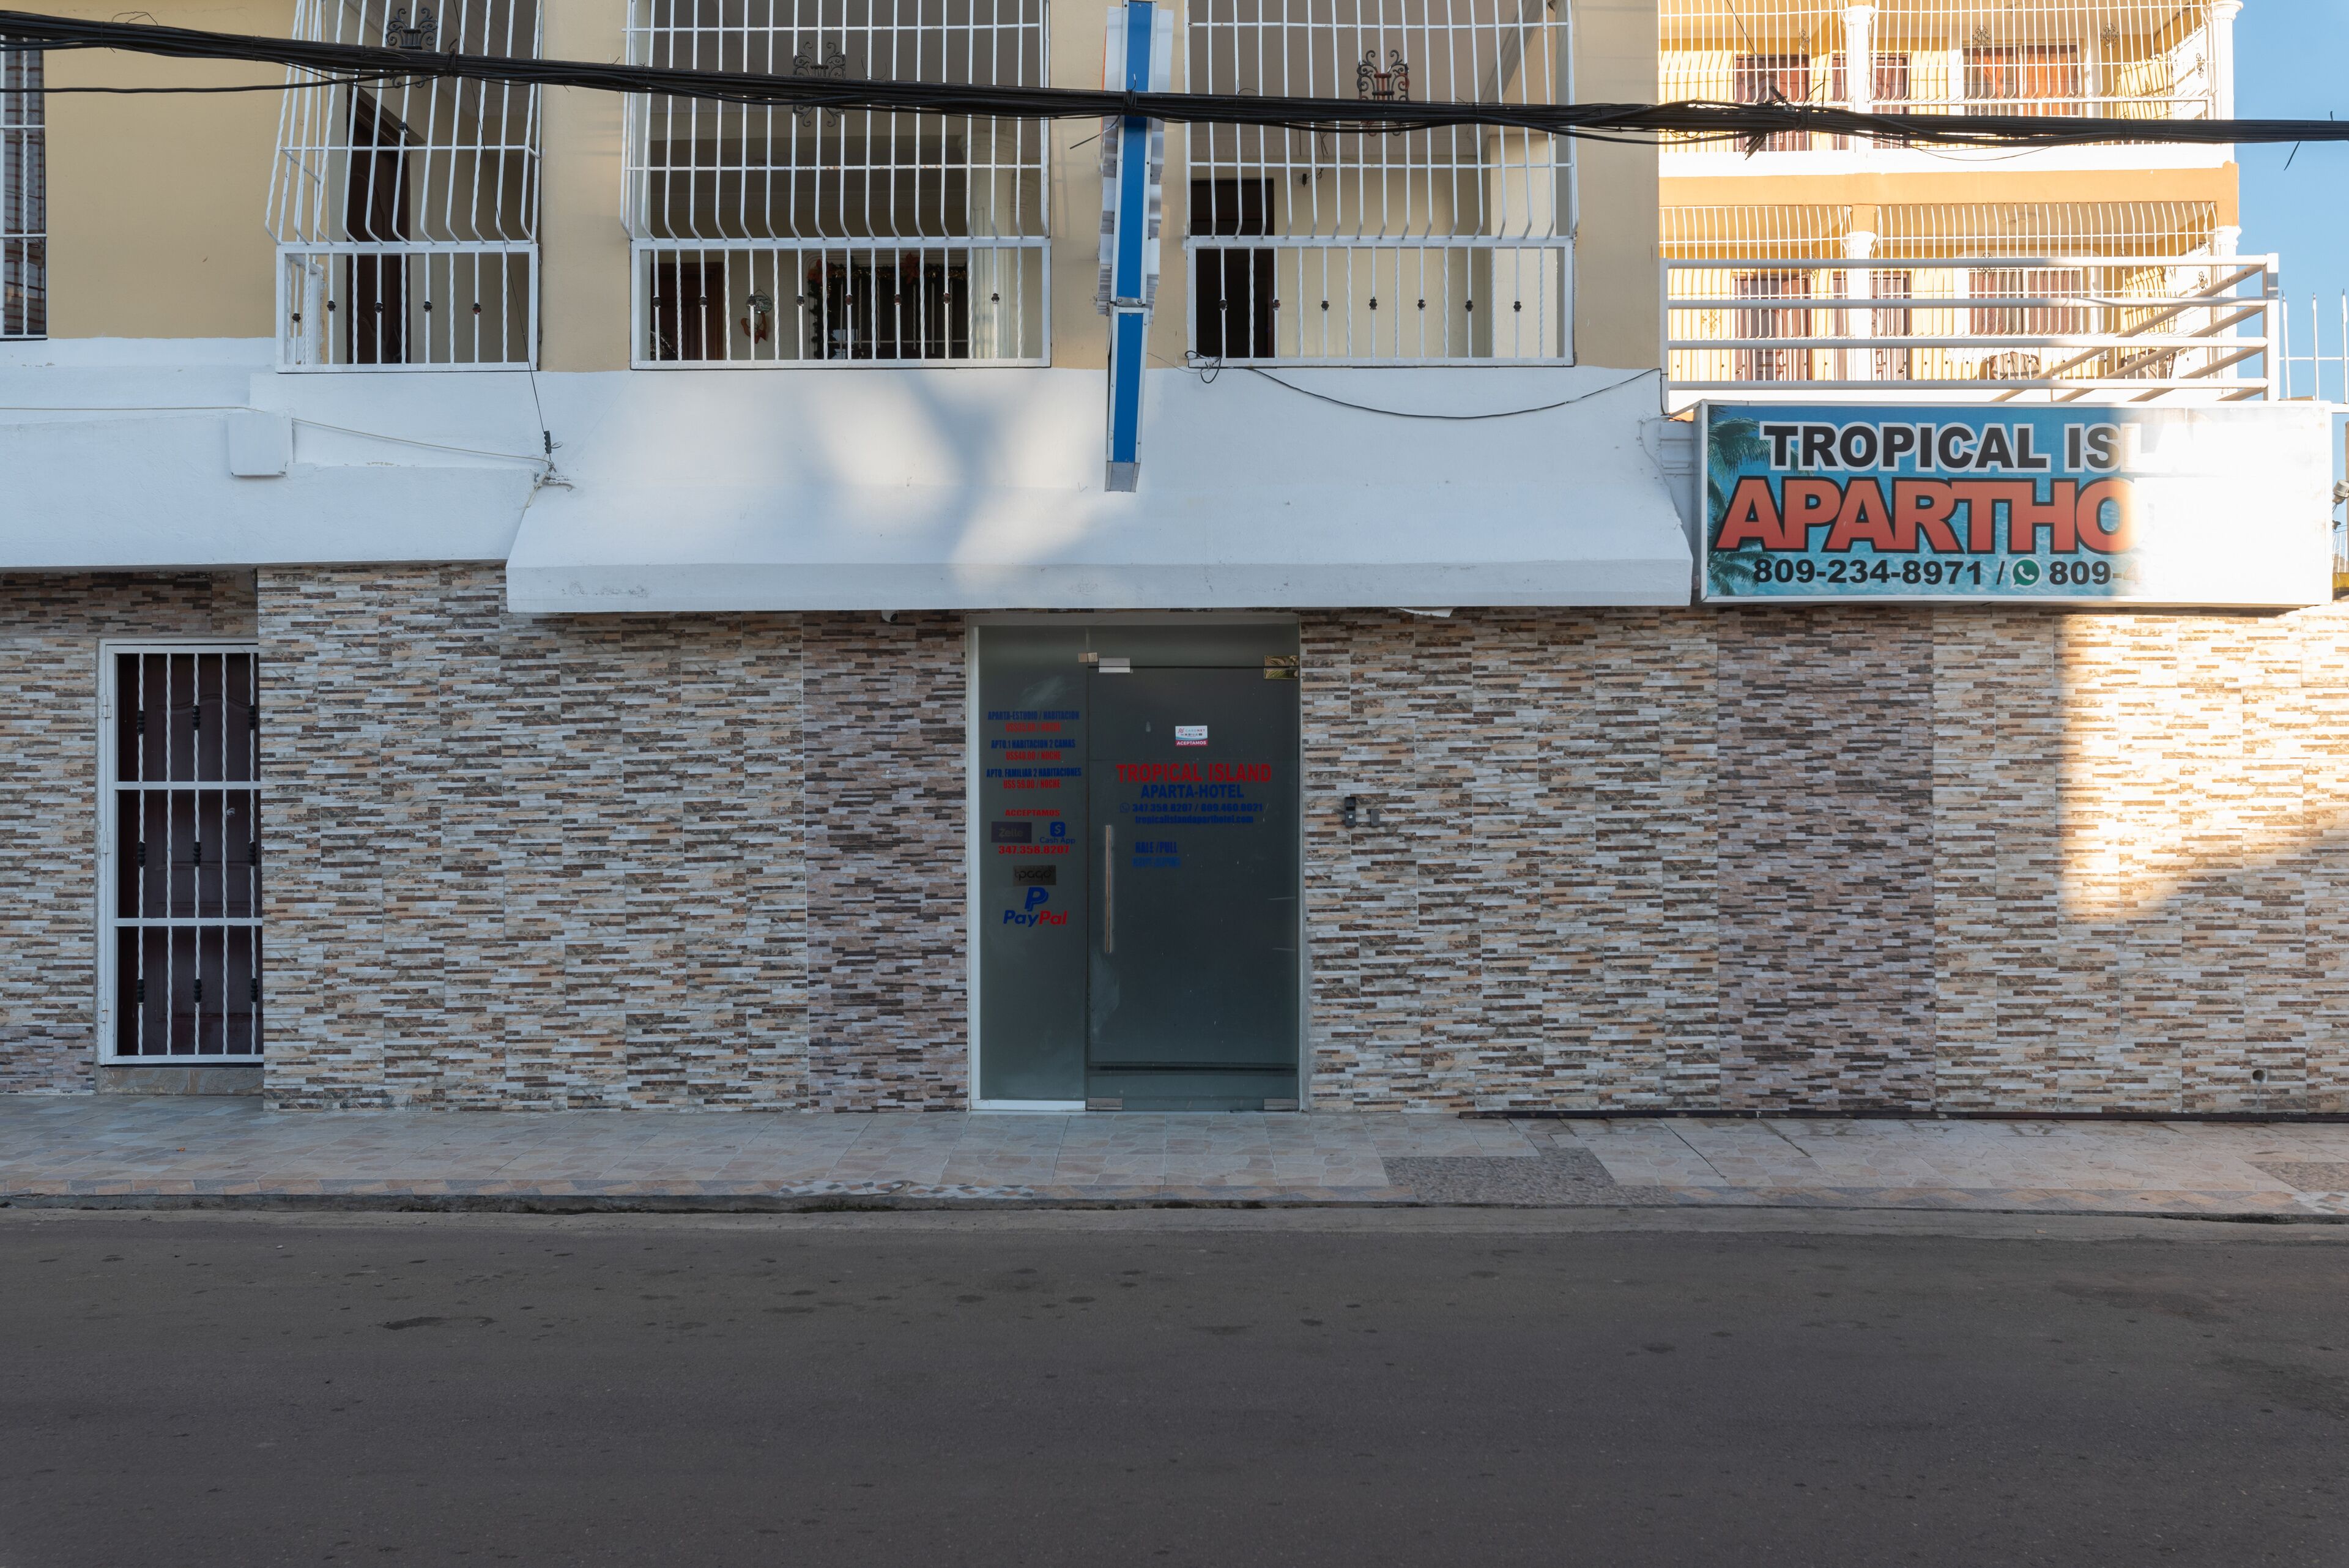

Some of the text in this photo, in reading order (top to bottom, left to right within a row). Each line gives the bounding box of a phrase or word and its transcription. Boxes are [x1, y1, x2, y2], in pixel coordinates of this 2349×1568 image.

[1762, 425, 2049, 470] TROPICAL
[1753, 559, 1983, 585] 809-234-8971
[1044, 710, 1080, 719] HABITACION
[1012, 739, 1048, 749] HABITACION
[1049, 739, 1053, 748] 2
[1055, 738, 1076, 748] CAMAS
[1041, 751, 1061, 760] NOCHE
[987, 767, 1082, 778] APTO. FAMILIAR 2 HABITACIONES
[1116, 763, 1272, 783] TROPICAL ISLAND
[1017, 779, 1034, 789] 59.00
[1041, 778, 1061, 789] NOCHE
[1141, 784, 1244, 798] APARTA-HOTEL
[1132, 803, 1192, 812] 347.358.8207
[1135, 814, 1253, 825] tropicalislandaparthotel.com
[998, 827, 1023, 838] Zelle
[1060, 836, 1076, 845] App
[998, 845, 1070, 855] 347.358.8207
[1003, 910, 1068, 927] PayPal
